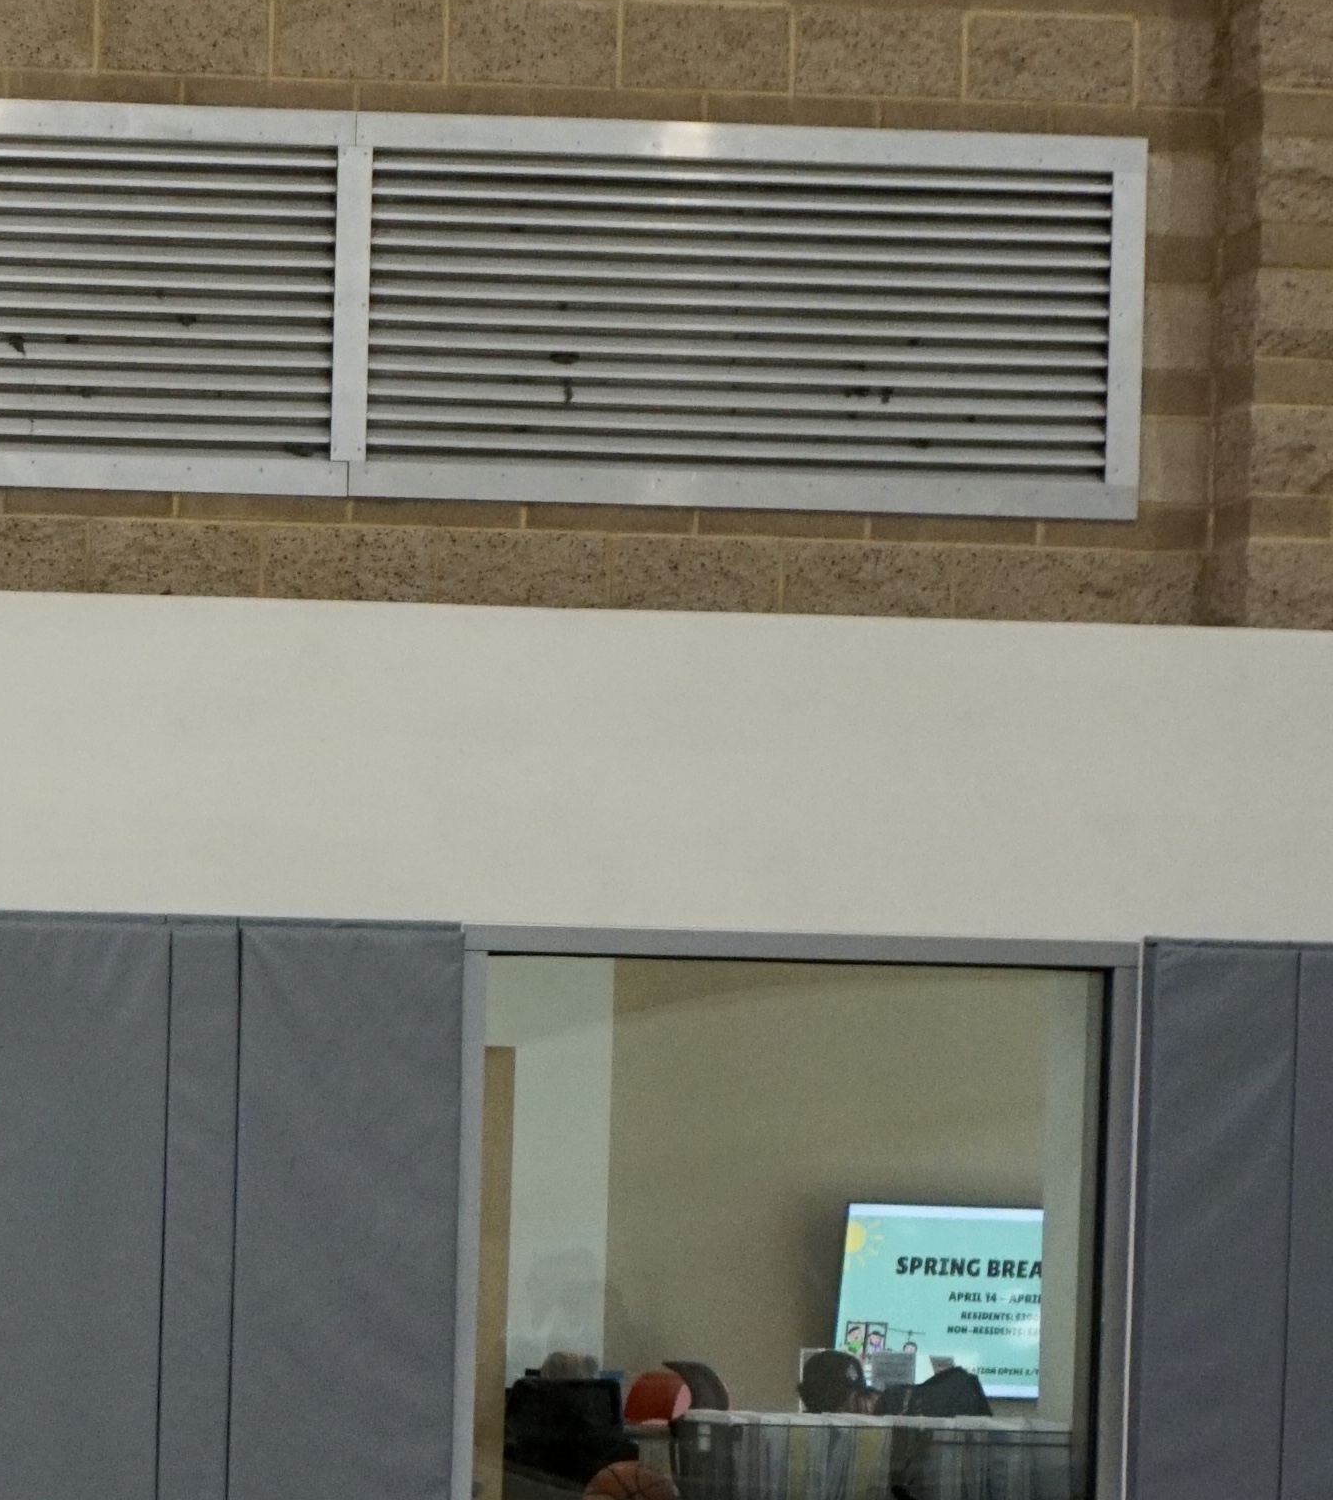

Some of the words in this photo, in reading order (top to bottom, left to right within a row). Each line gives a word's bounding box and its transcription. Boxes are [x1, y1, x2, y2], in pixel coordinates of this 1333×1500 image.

[895, 1255, 981, 1277] SPRING
[986, 1258, 1042, 1279] BREA
[948, 1291, 982, 1303] APRIL
